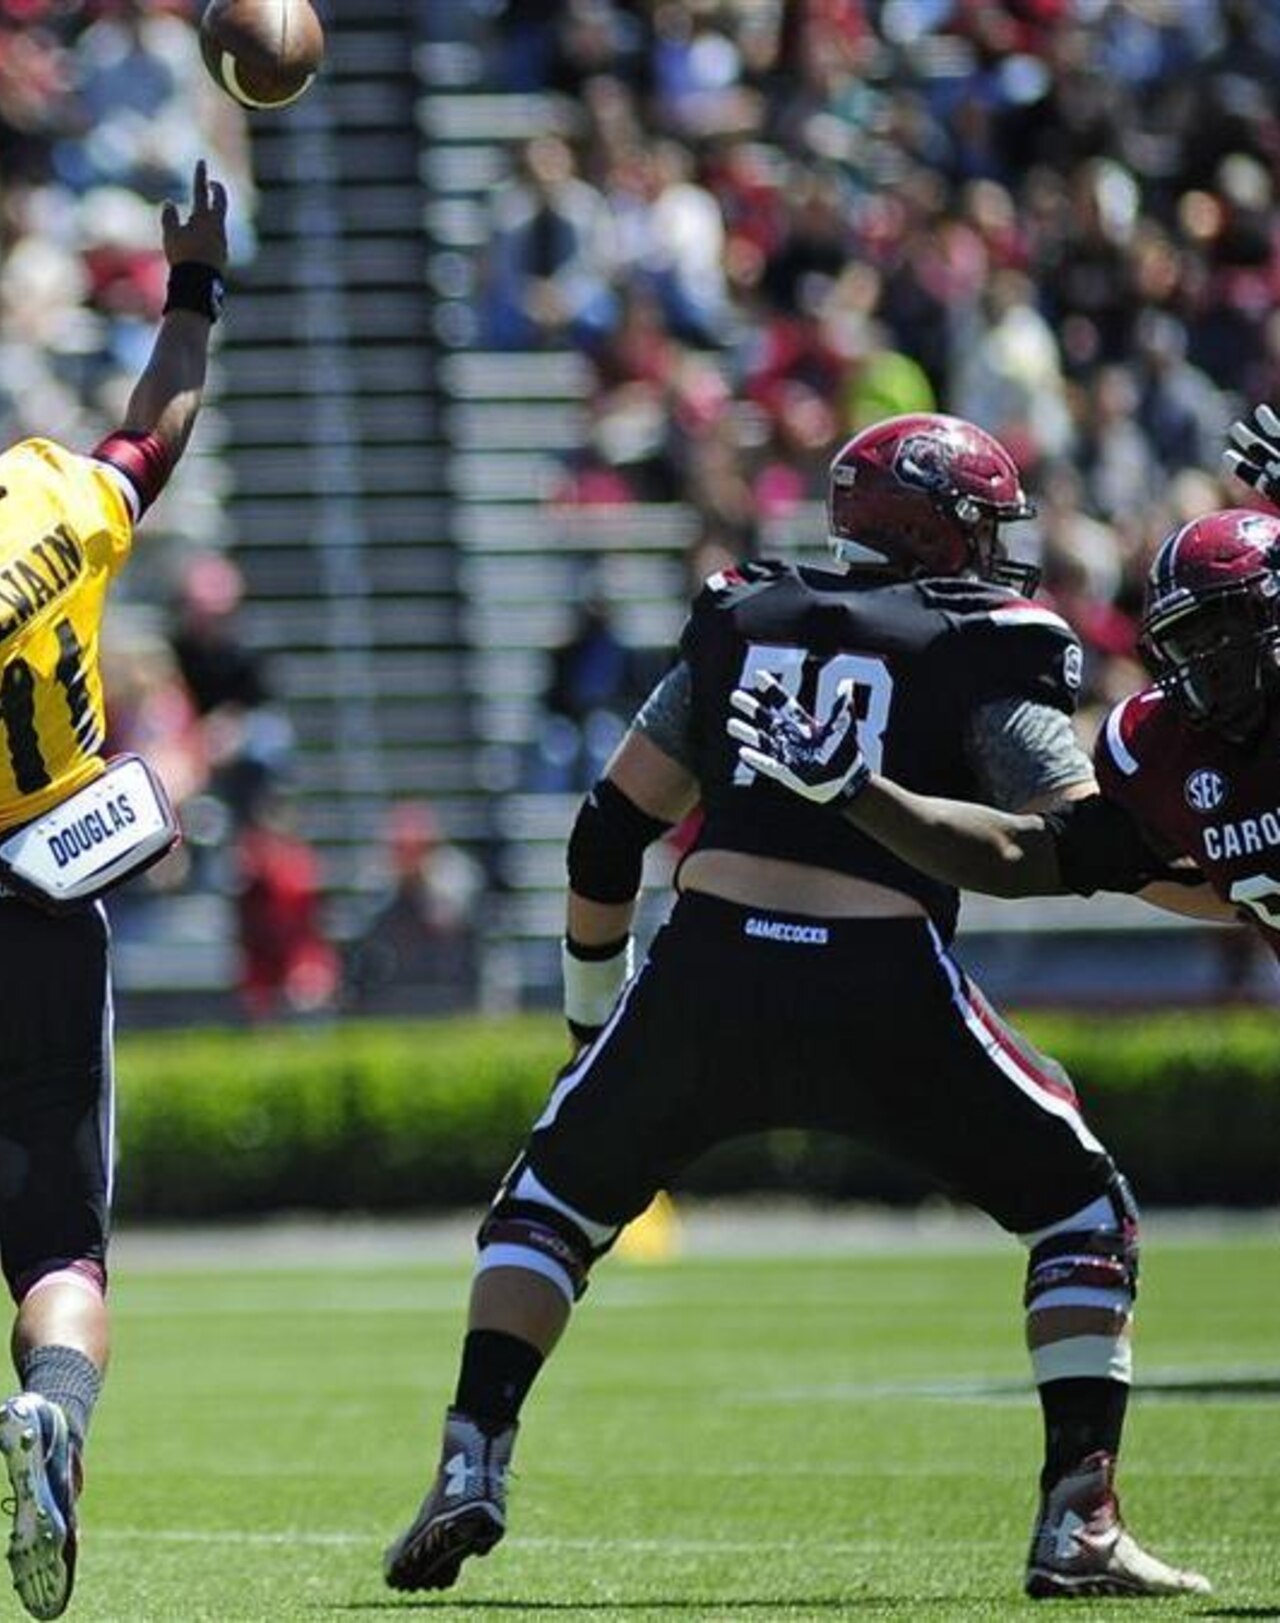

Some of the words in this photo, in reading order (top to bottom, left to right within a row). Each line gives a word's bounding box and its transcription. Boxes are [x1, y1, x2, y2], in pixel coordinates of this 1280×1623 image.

[1188, 770, 1225, 810] SEC
[47, 793, 137, 869] DOUGLAS
[1203, 807, 1280, 860] CARO
